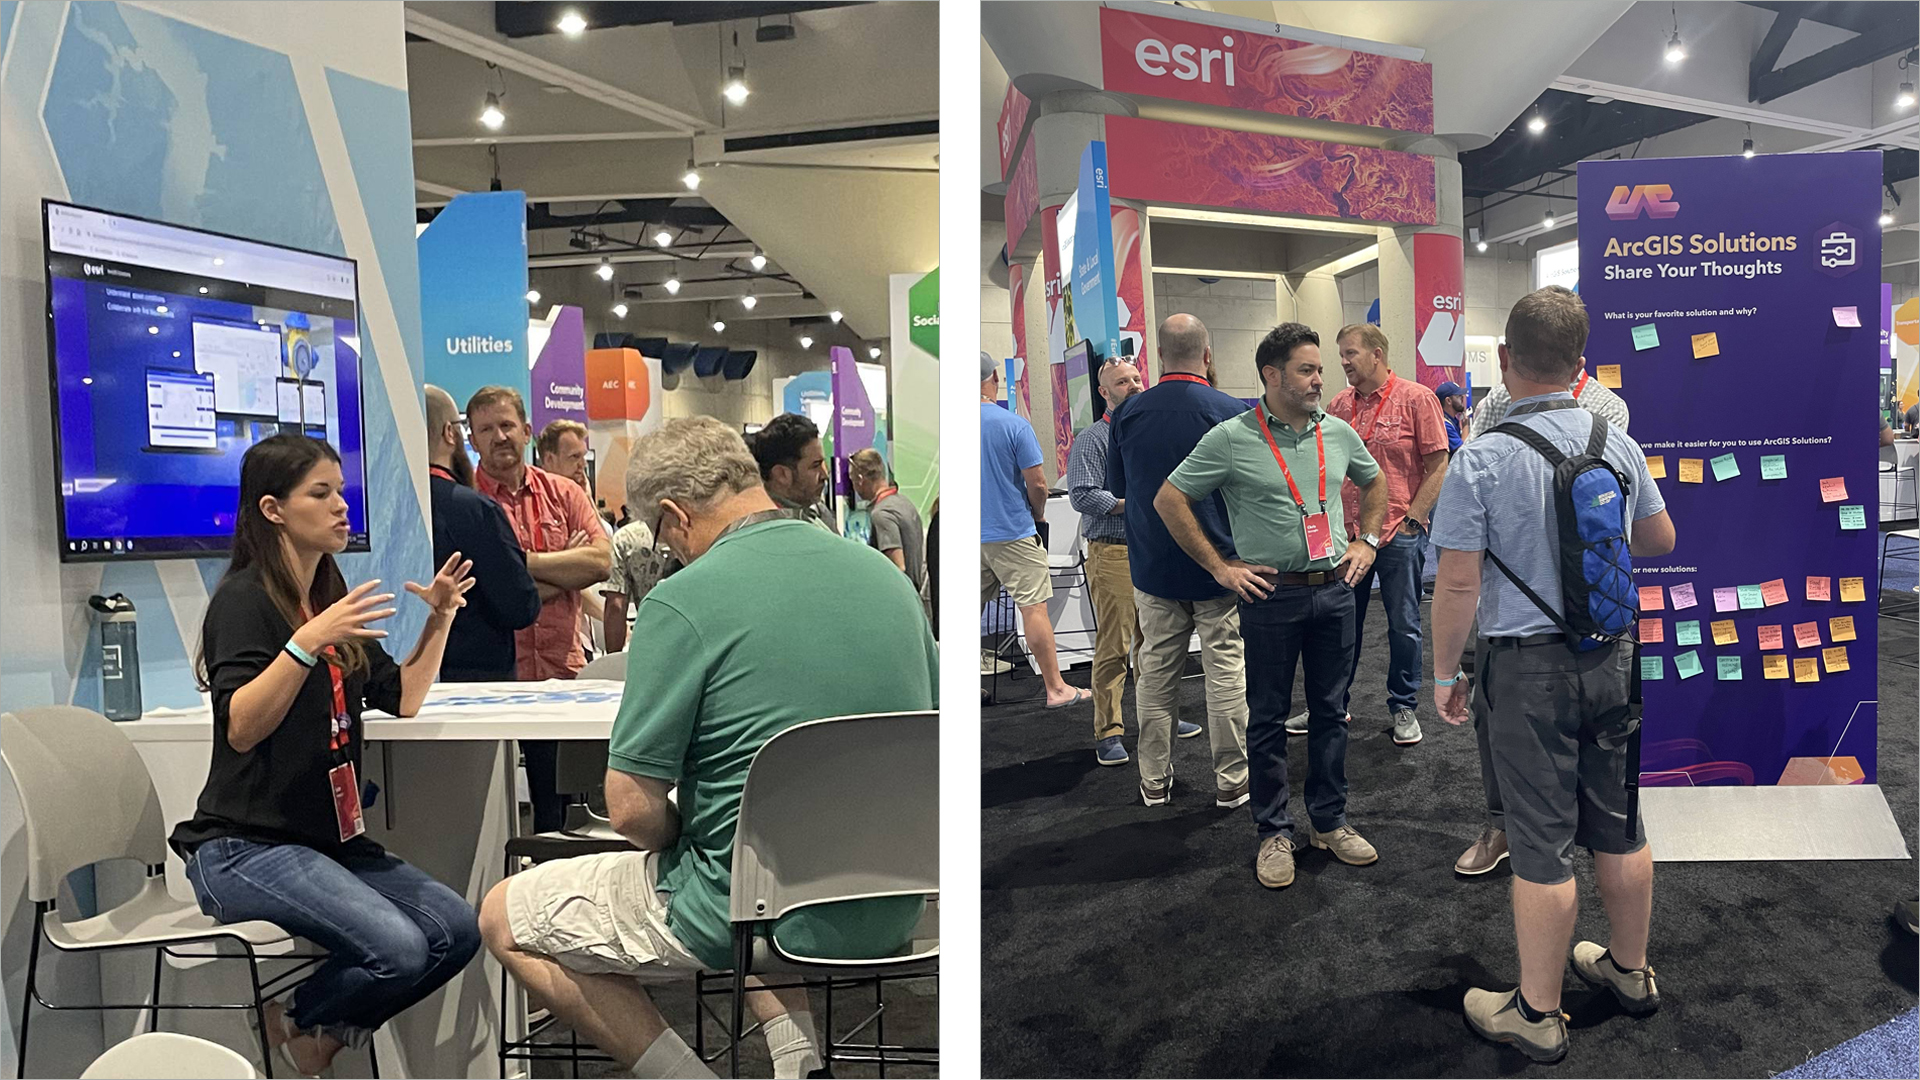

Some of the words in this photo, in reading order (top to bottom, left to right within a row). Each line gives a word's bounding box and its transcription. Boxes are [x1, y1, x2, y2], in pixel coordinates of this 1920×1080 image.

[1275, 24, 1281, 33] 3
[1135, 35, 1235, 86] esri
[1095, 167, 1107, 189] esri
[1603, 235, 1684, 258] ArcGIS
[1689, 231, 1797, 255] Solutions
[1604, 264, 1653, 280] Share
[1656, 263, 1697, 278] Your
[1700, 259, 1782, 279] Thoughts
[1433, 292, 1462, 311] esri
[1604, 312, 1626, 320] What
[1627, 311, 1634, 319] is
[1635, 311, 1653, 321] your
[1654, 309, 1685, 318] favorite
[1686, 308, 1718, 317] solution
[1719, 307, 1734, 316] and
[1735, 307, 1758, 317] why?
[446, 335, 514, 355] Utilities
[550, 382, 584, 398] Community
[602, 380, 620, 389] AEC
[544, 396, 586, 413] Development
[1654, 440, 1676, 449] make
[1677, 440, 1683, 448] it
[1684, 439, 1708, 448] easier
[1709, 438, 1721, 447] for
[1722, 440, 1737, 448] you
[1763, 437, 1790, 446] ArcGIS
[1791, 436, 1832, 445] Solutions?
[1660, 565, 1698, 573] solutions:
